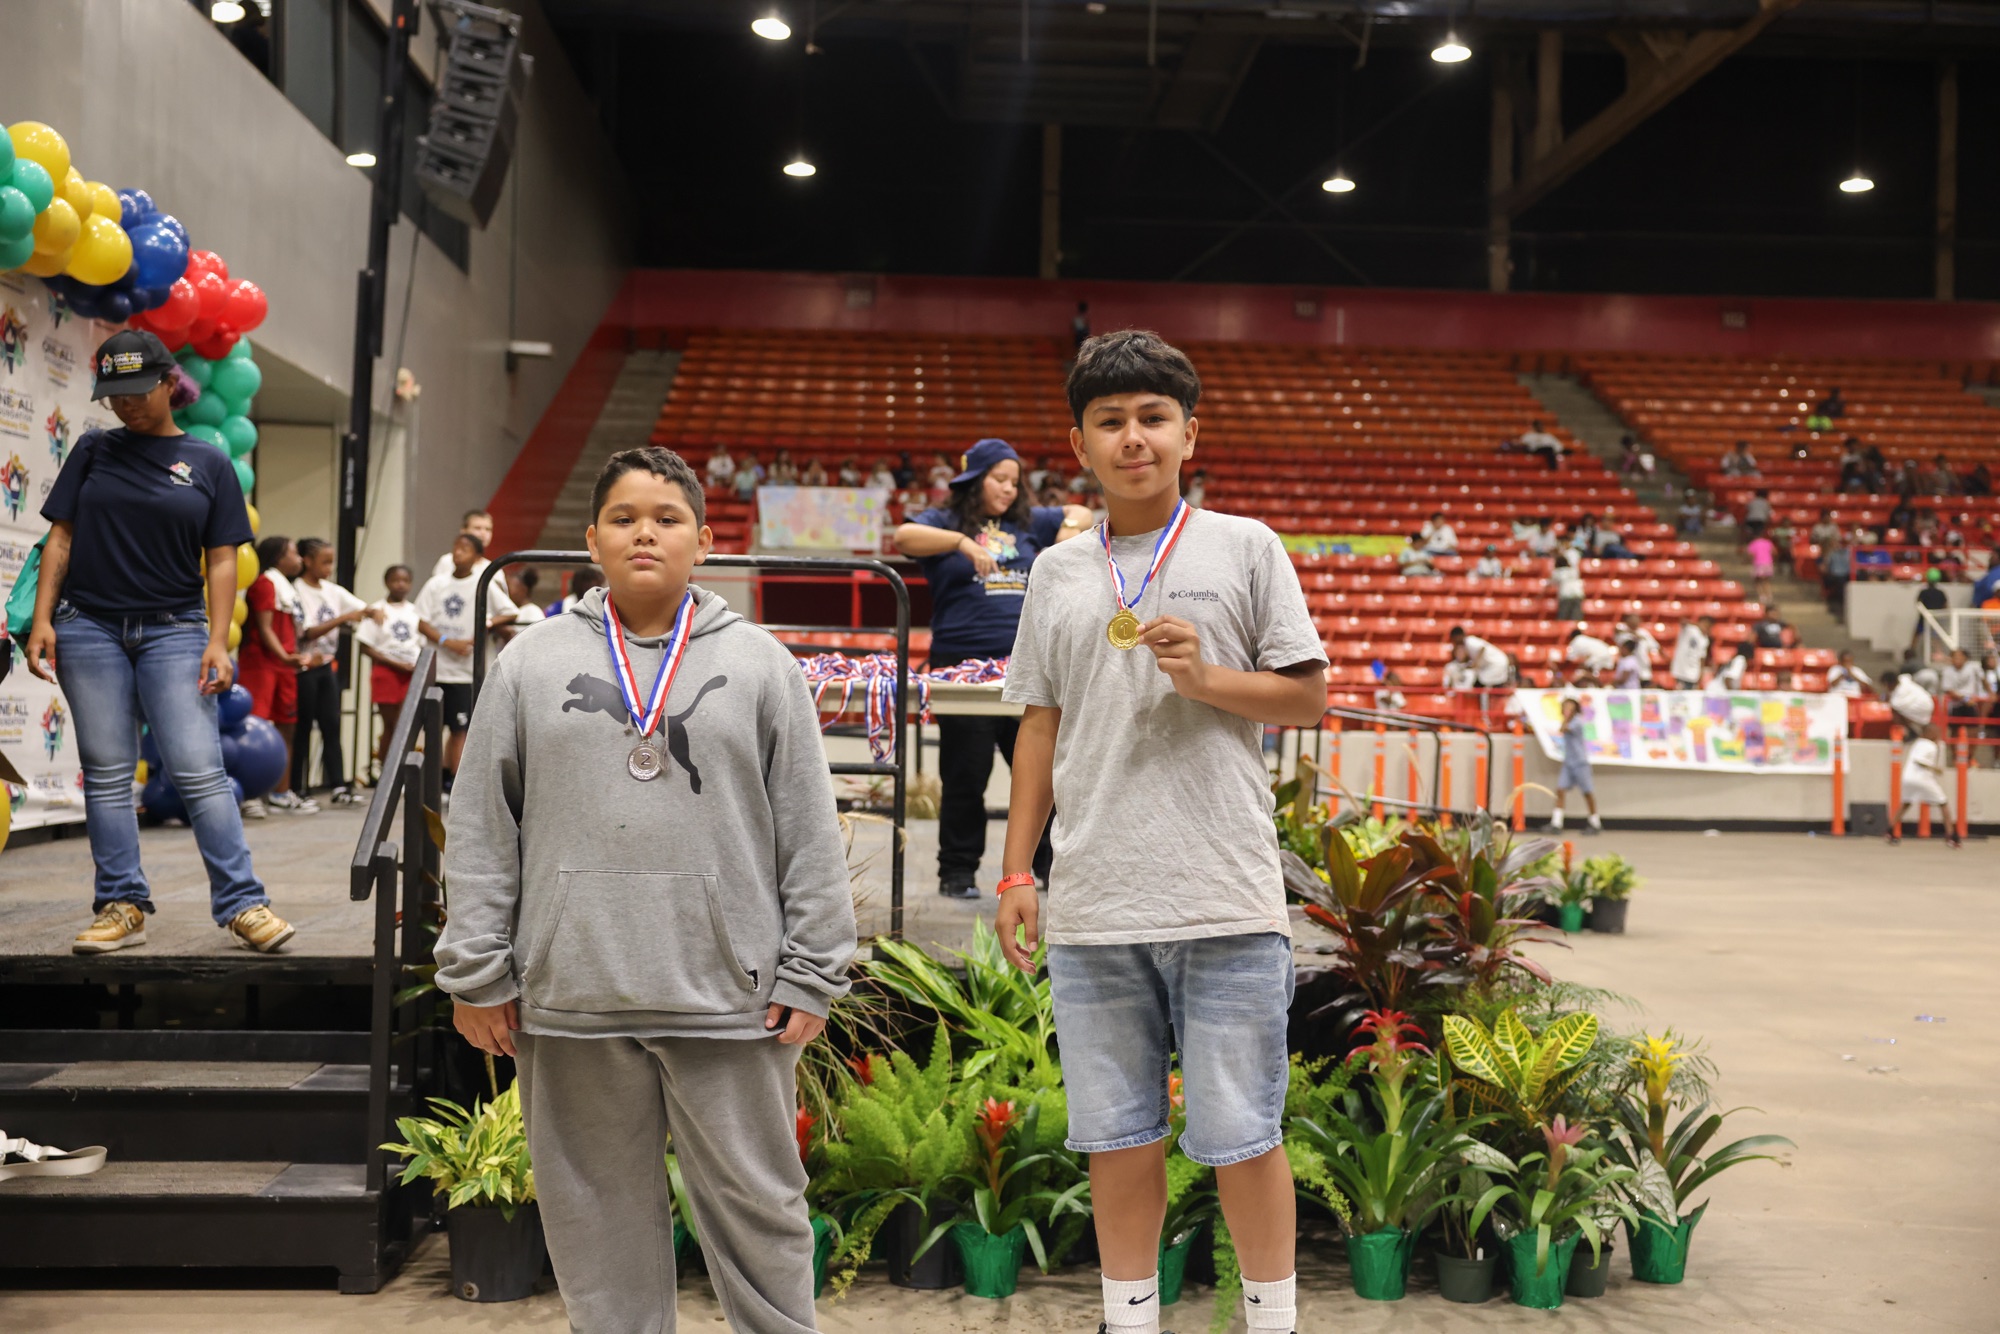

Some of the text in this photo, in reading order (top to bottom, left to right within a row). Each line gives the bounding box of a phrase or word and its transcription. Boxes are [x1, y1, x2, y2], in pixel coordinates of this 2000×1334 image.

[1178, 589, 1219, 599] Columbia
[1120, 622, 1128, 637] 1
[640, 752, 651, 766] 2
